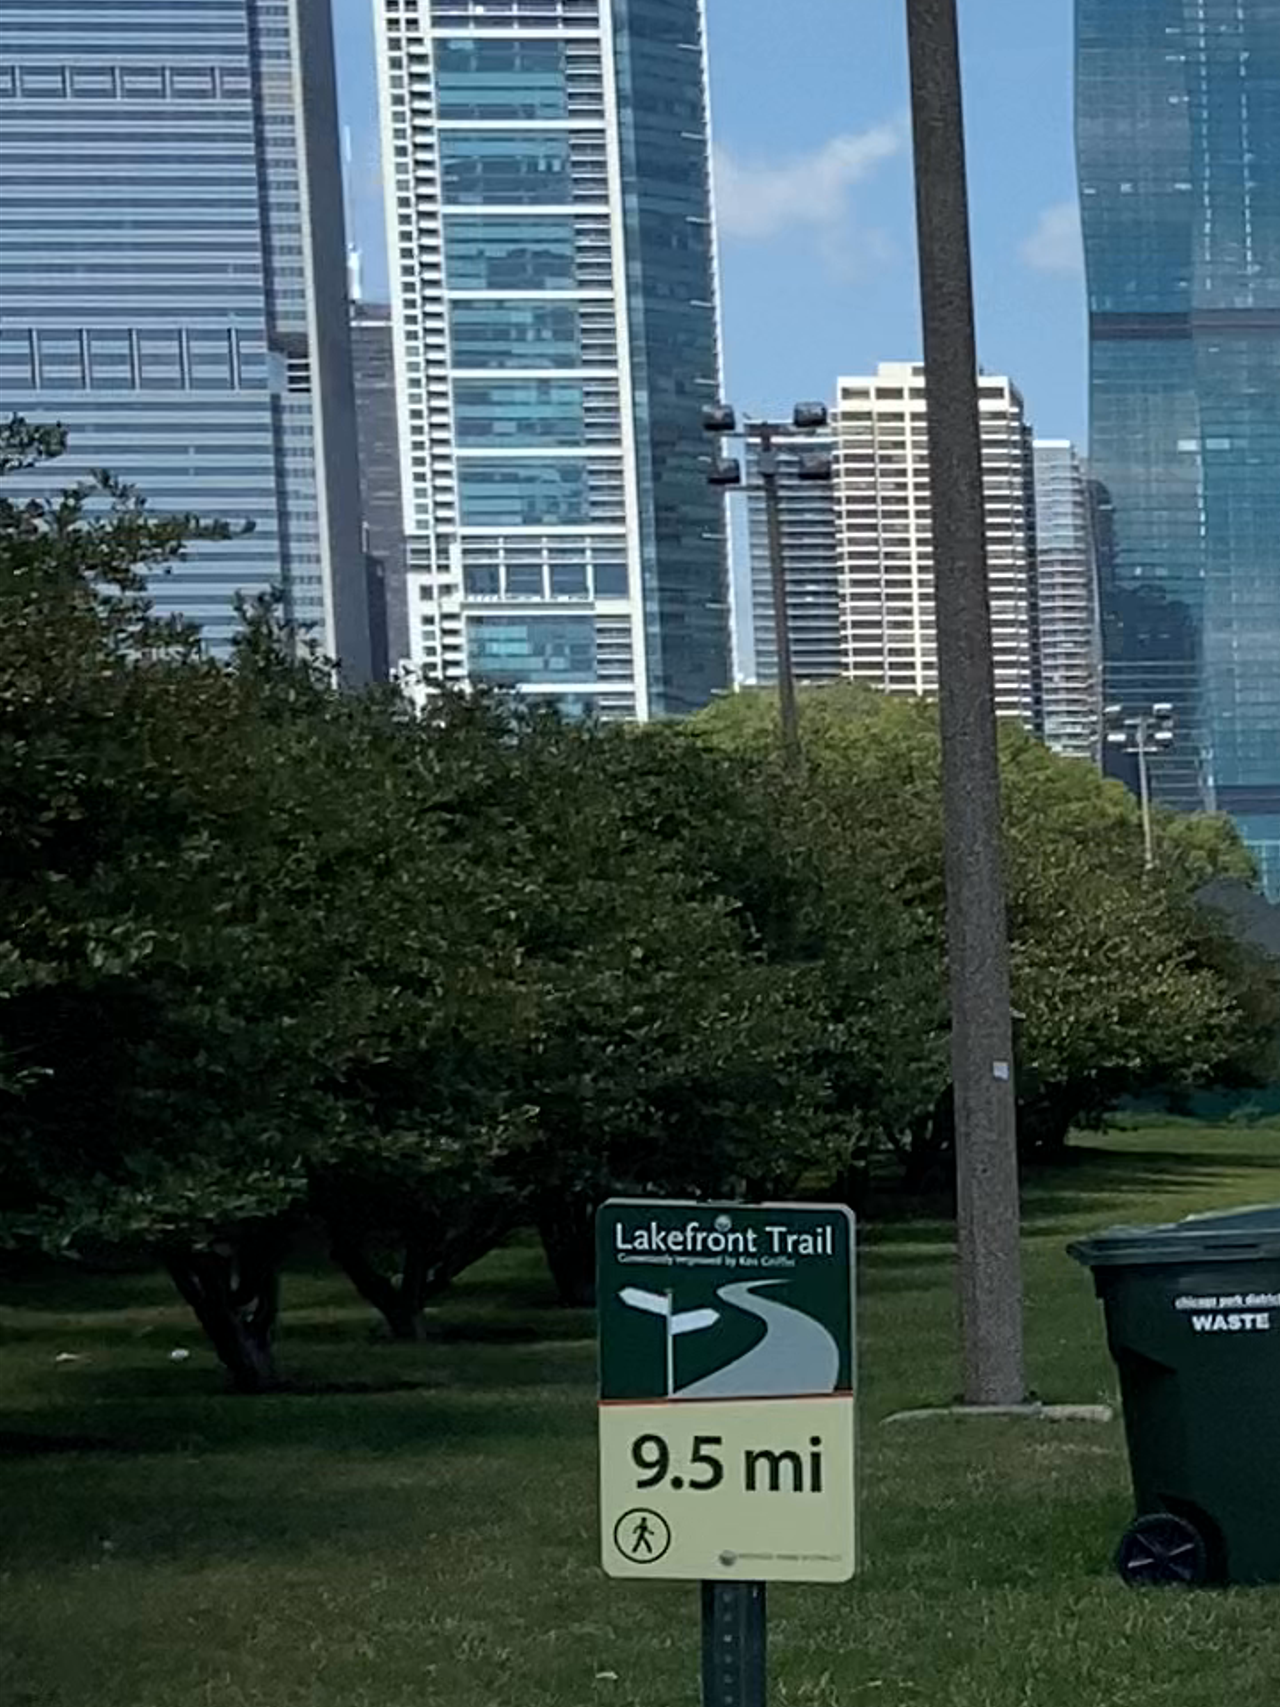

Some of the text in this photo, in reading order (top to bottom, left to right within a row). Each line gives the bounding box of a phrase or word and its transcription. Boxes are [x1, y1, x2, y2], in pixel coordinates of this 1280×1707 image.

[615, 1221, 833, 1255] Lakefront Trail
[1192, 1313, 1269, 1331] WASTE
[631, 1433, 823, 1493] 9.5 mi
